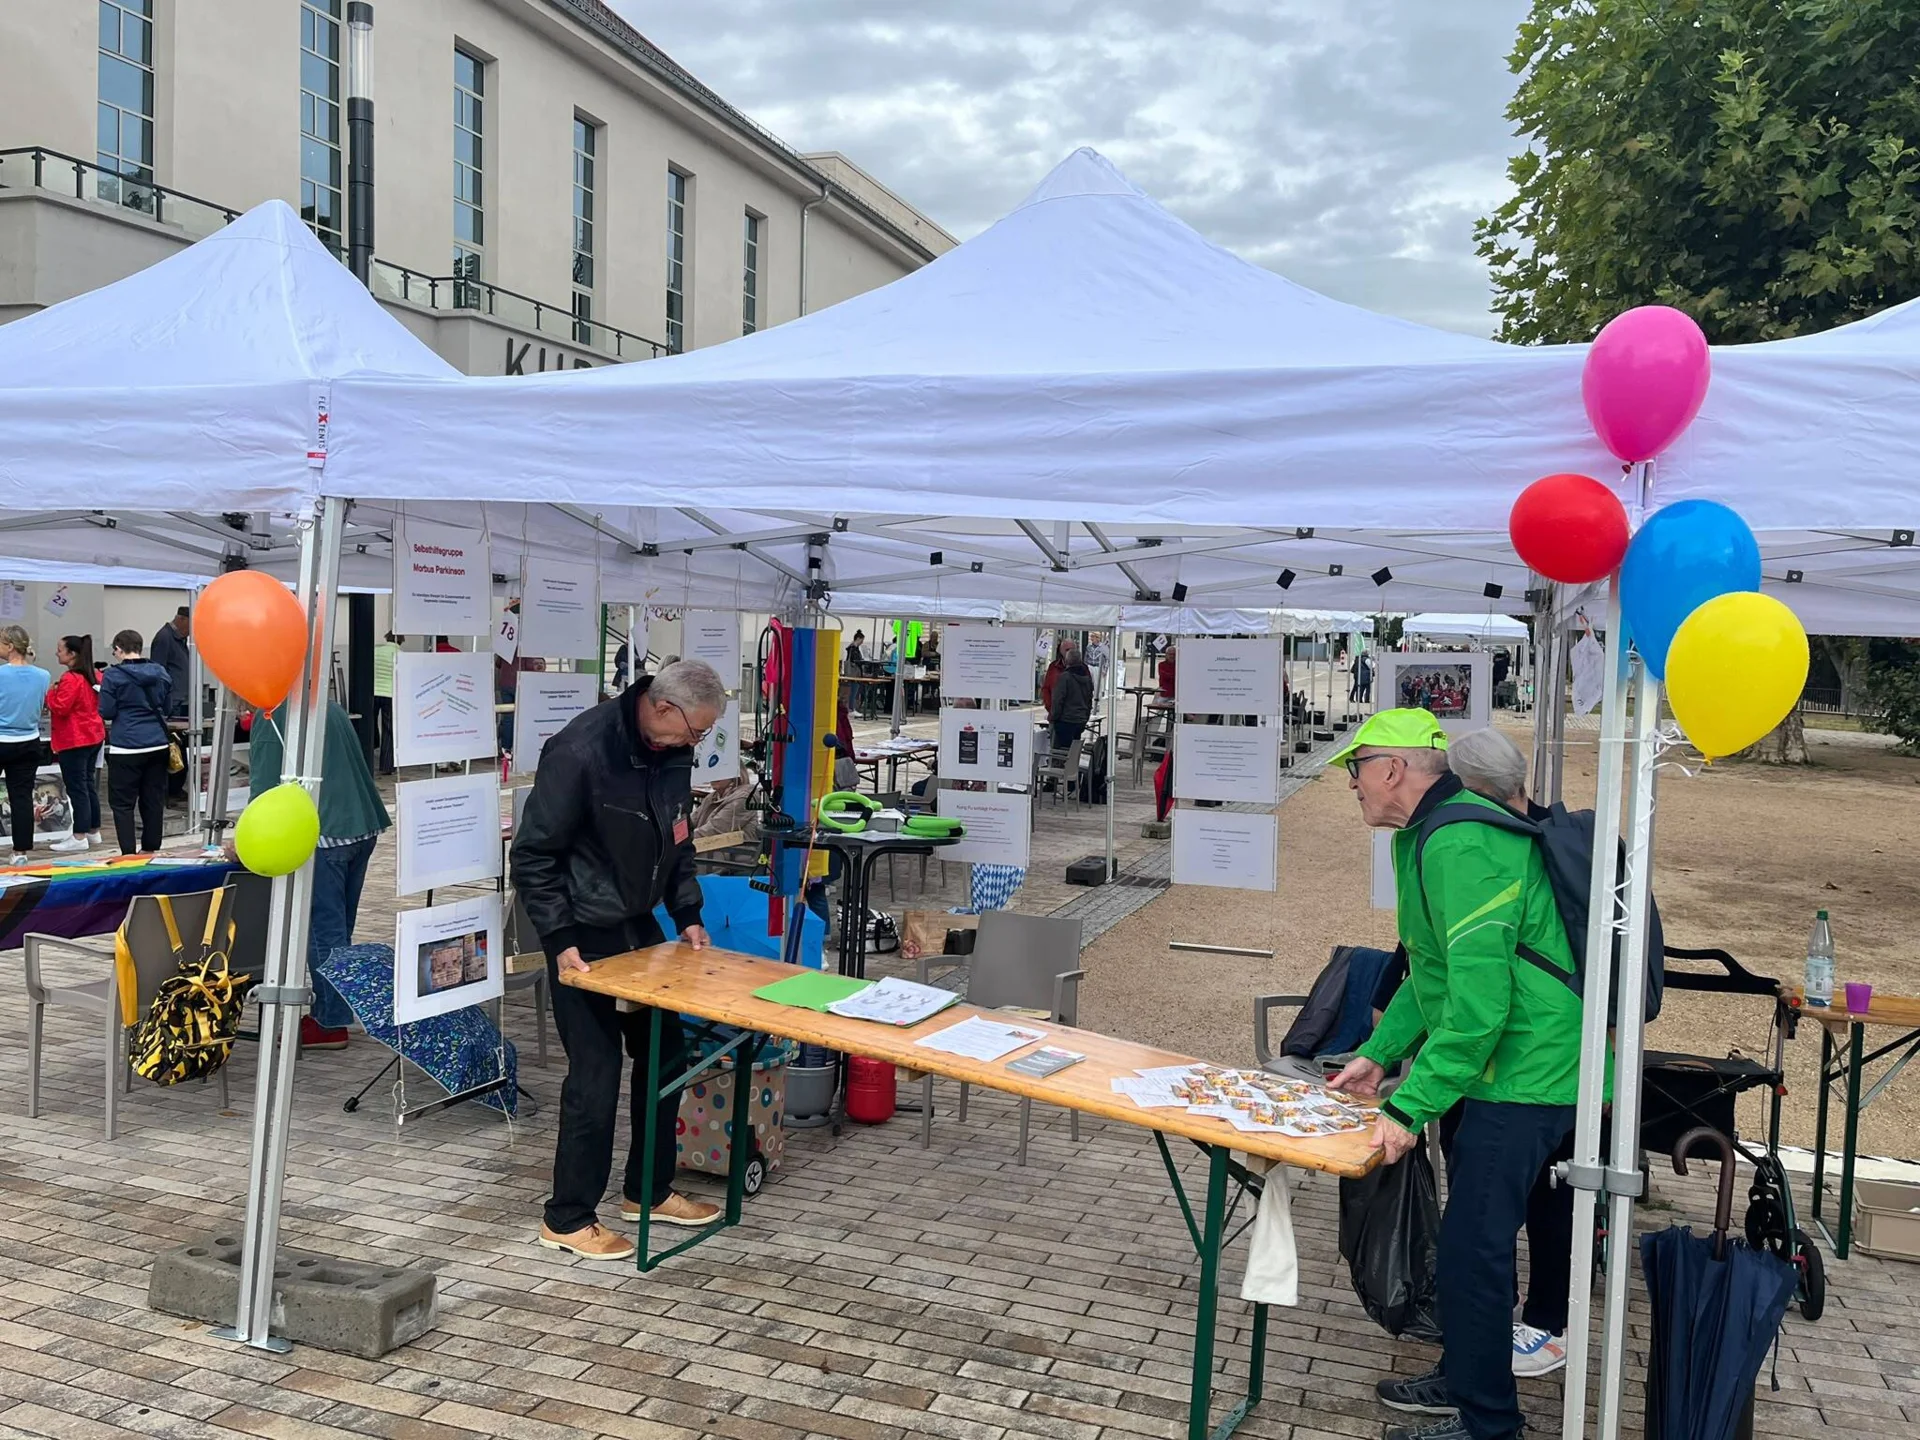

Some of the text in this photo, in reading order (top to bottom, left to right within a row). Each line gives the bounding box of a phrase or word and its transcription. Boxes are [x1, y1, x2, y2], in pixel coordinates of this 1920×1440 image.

[413, 543, 463, 557] Selbsthilfegruppe
[413, 563, 466, 576] Morbus Parkinson
[52, 594, 68, 608] 23
[500, 621, 515, 641] 18
[1038, 640, 1048, 650] 15
